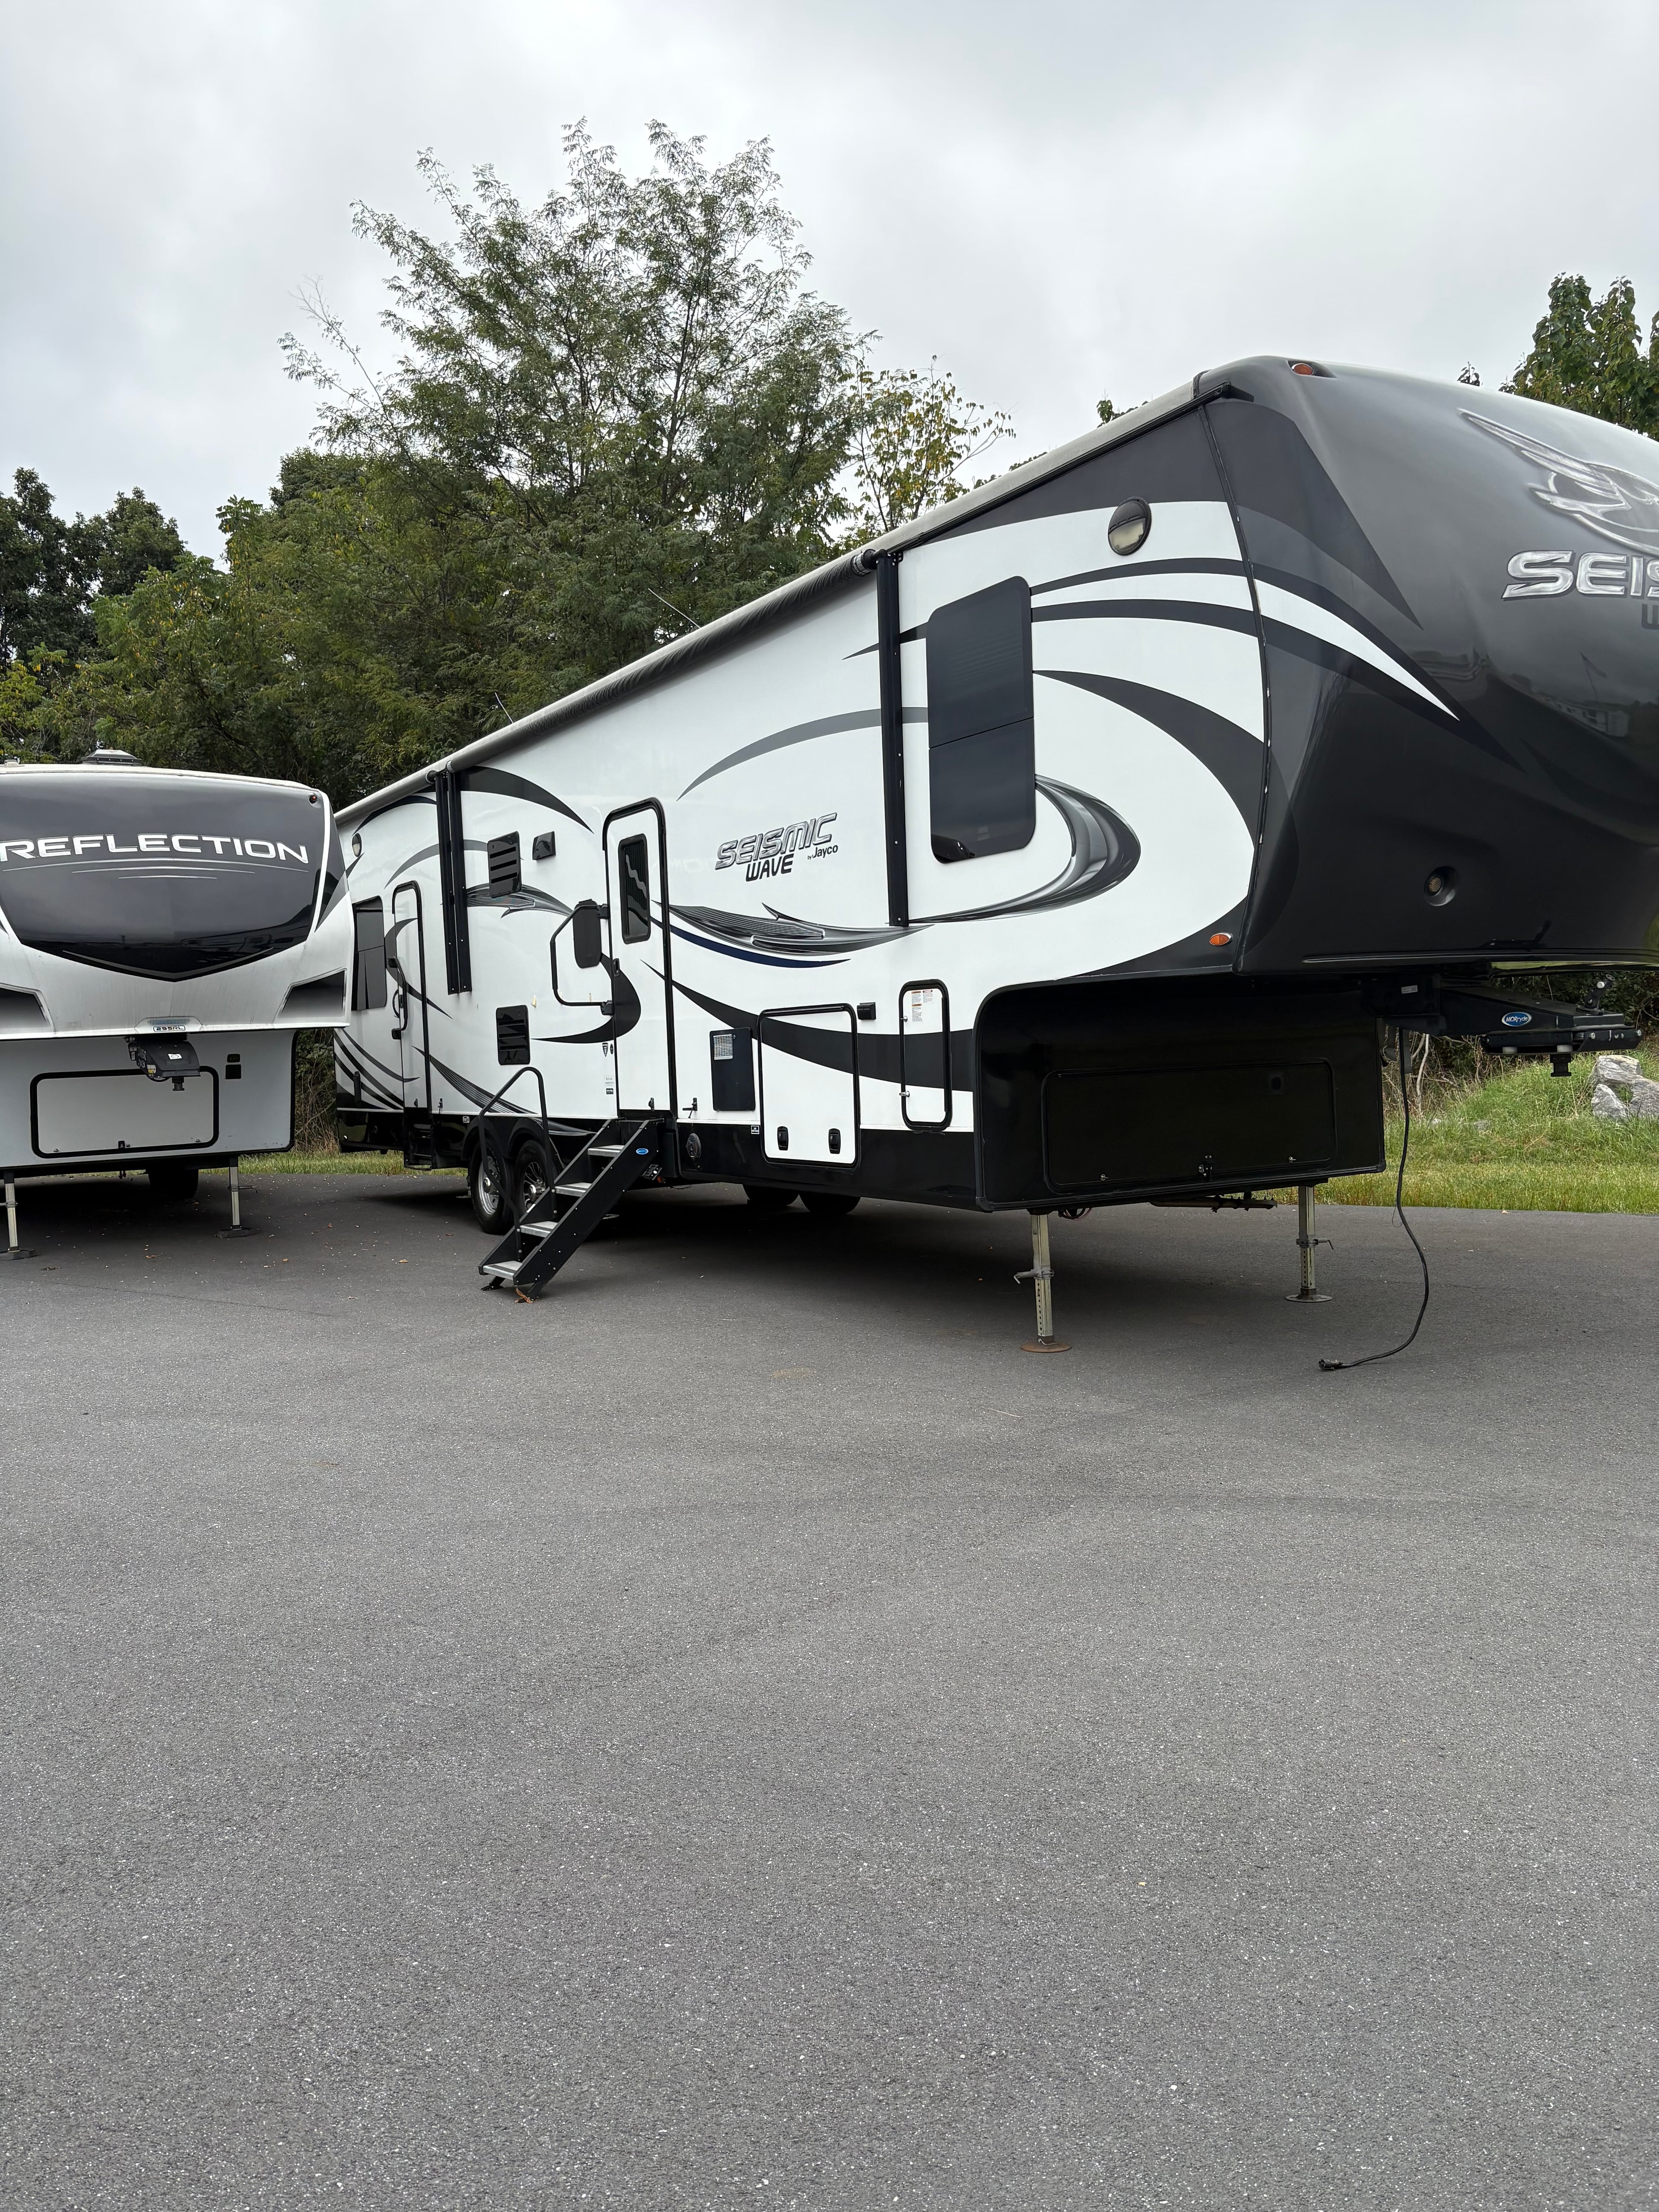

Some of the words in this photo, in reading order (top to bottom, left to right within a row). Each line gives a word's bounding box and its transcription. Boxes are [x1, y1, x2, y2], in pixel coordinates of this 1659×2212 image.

[1501, 550, 1659, 601] SEI
[0, 834, 309, 864] REFLECTION
[715, 812, 837, 870] SEISMIC
[812, 845, 838, 858] Jayco
[746, 854, 794, 882] WAVE
